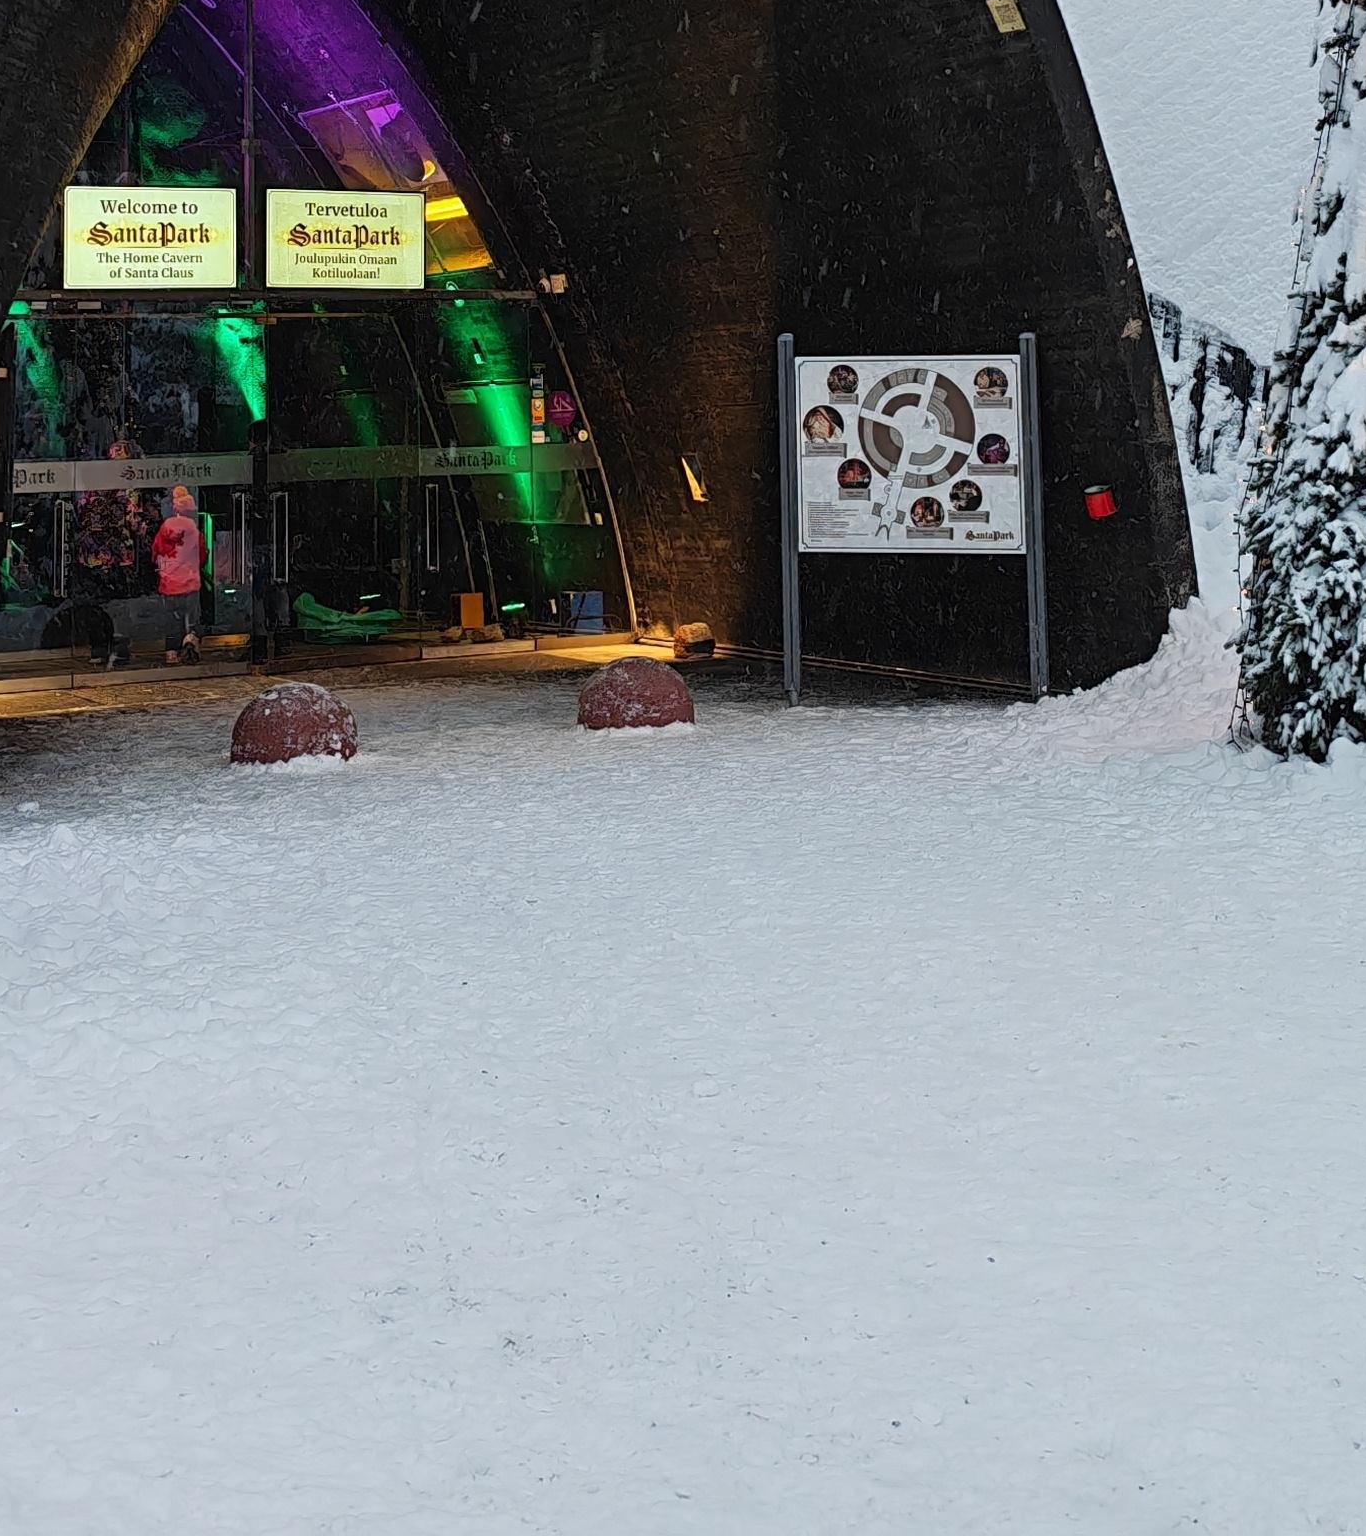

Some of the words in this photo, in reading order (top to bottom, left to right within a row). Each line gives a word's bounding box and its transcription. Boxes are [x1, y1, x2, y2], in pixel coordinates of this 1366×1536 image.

[100, 199, 177, 214] Welcome
[182, 201, 198, 215] to
[305, 202, 388, 218] Tervetuloa
[87, 221, 210, 247] SantaPark
[287, 223, 400, 249] SantaPark
[96, 252, 120, 263] The
[123, 252, 159, 263] Home
[161, 252, 203, 263] Cavern
[295, 253, 356, 266] Joulupukin
[359, 254, 397, 265] Omaan
[109, 267, 123, 278] of
[125, 267, 158, 278] Santa
[161, 267, 194, 278] Claus
[312, 267, 380, 279] Kotiluolaan!
